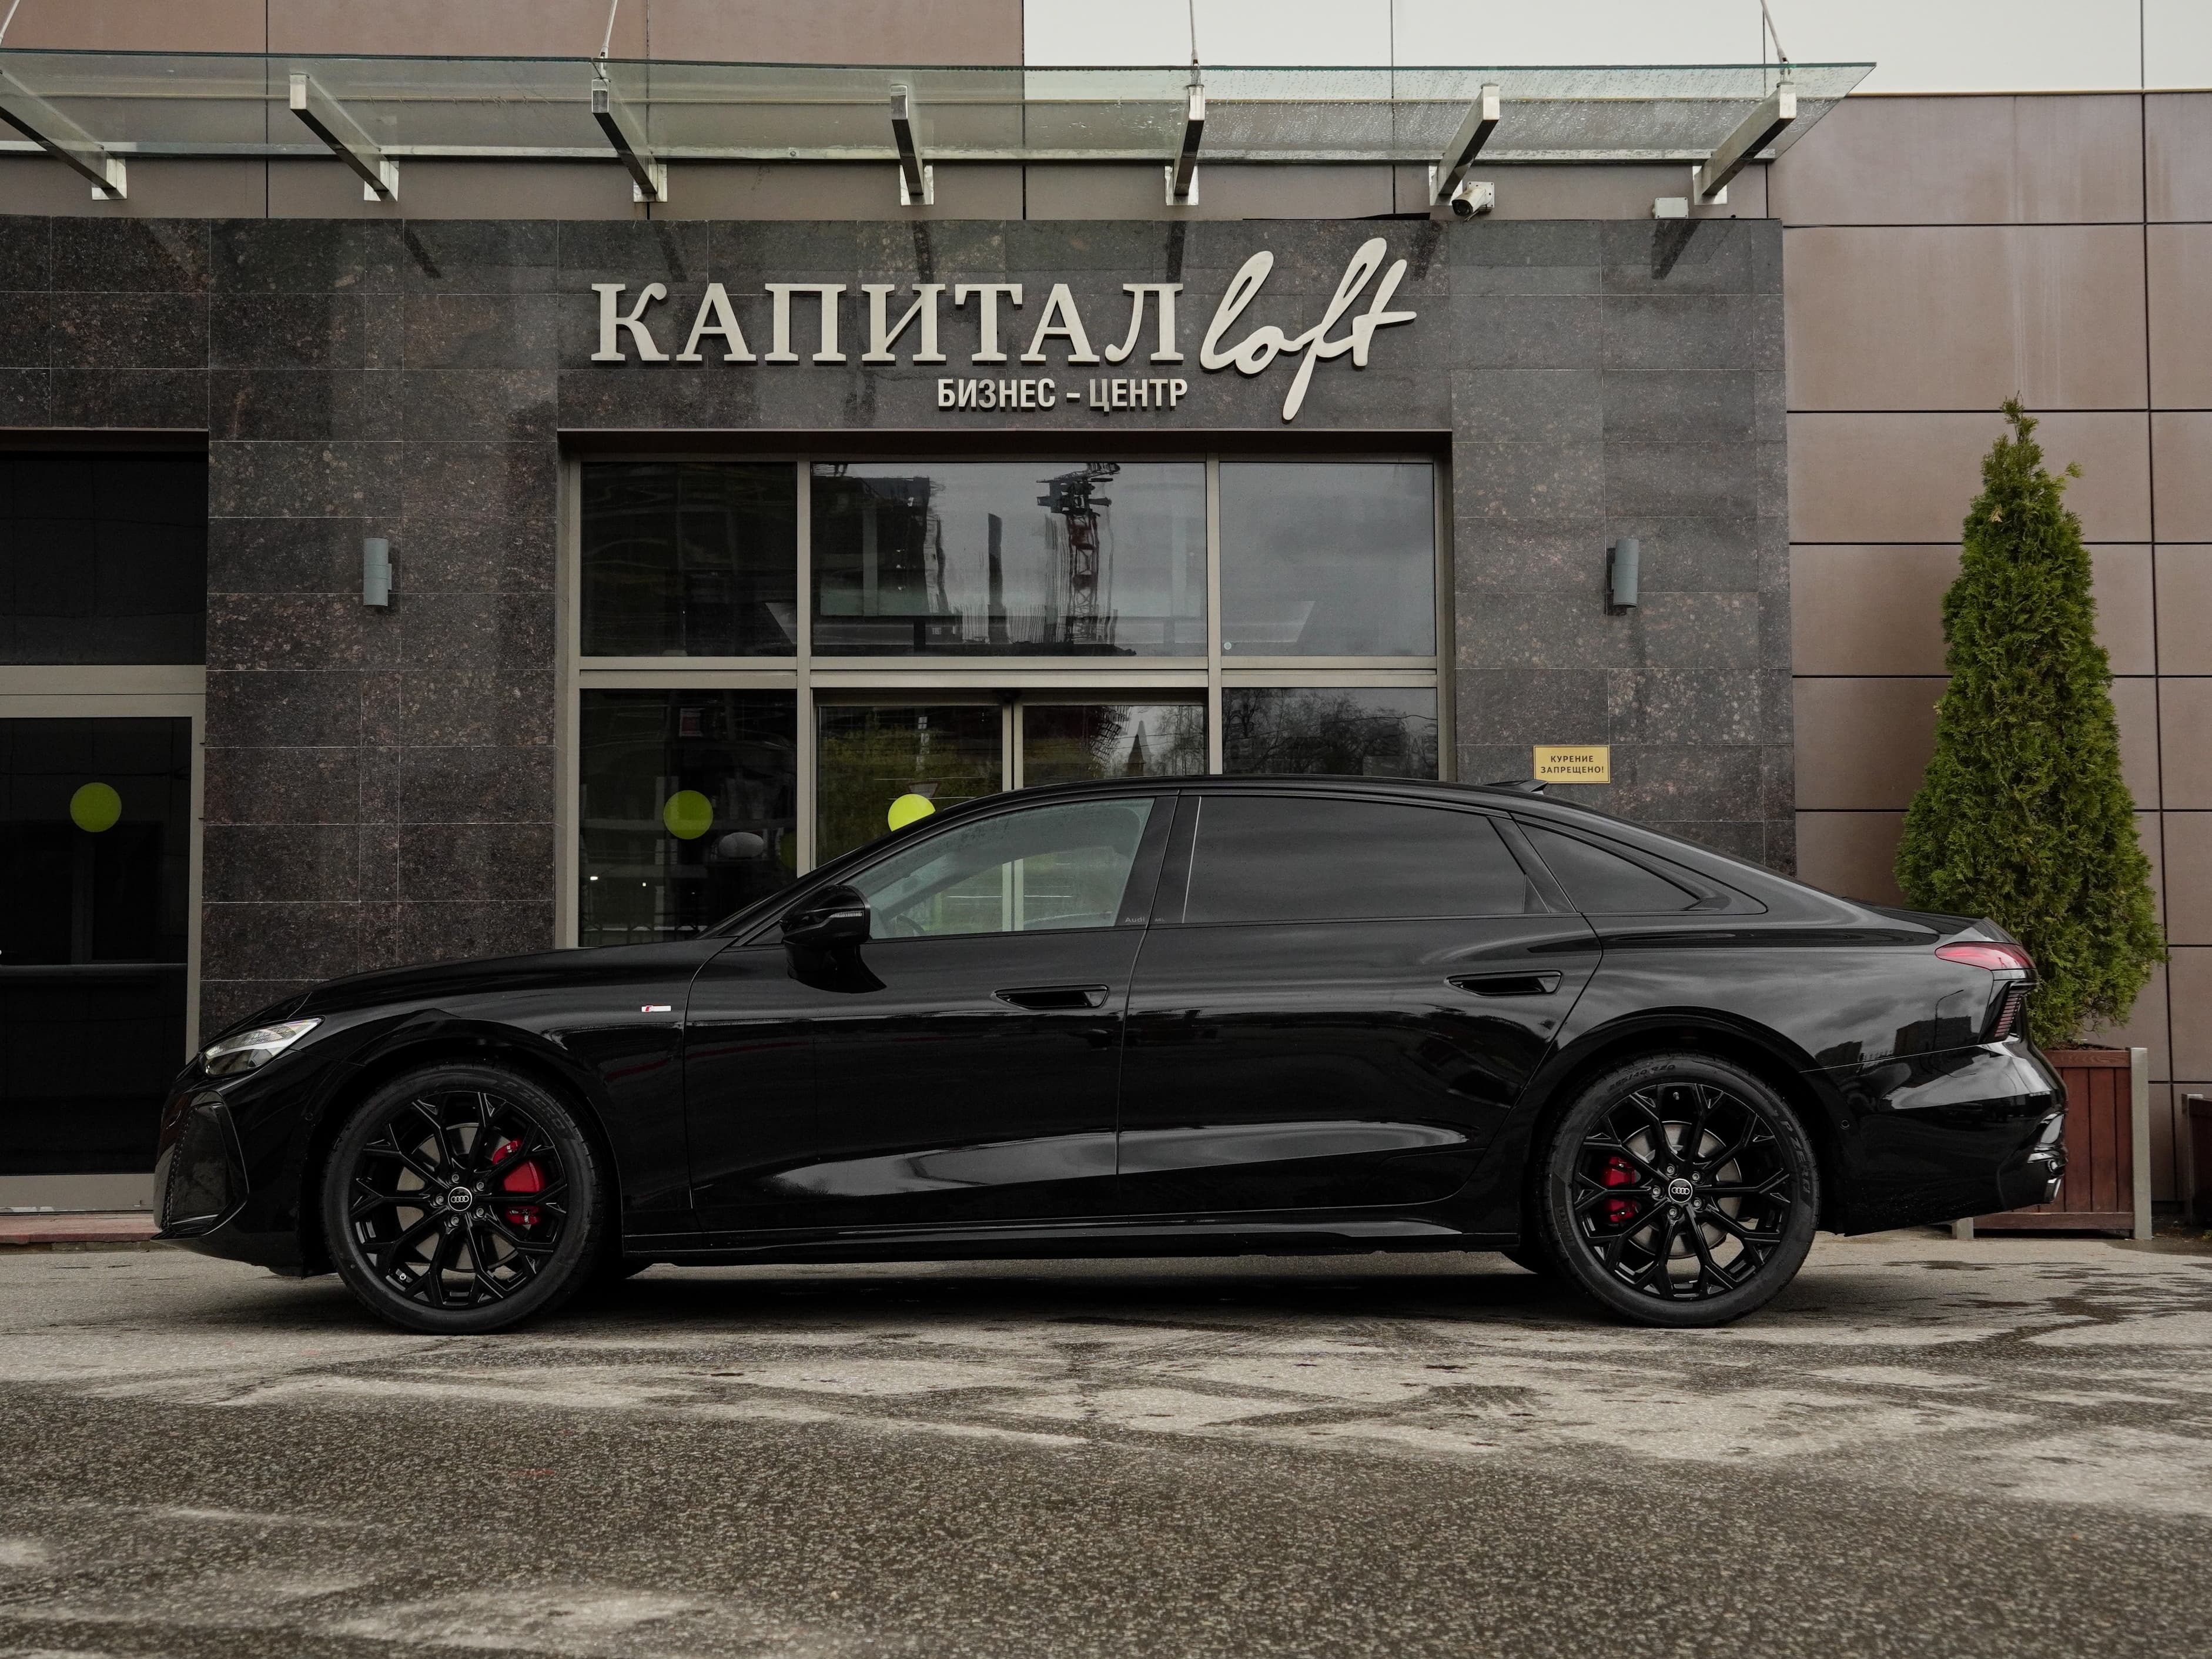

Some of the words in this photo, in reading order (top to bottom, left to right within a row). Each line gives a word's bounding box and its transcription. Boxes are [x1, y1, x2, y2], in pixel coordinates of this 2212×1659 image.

[590, 283, 1184, 362] КАПИТАЛ
[1199, 237, 1418, 421] loft
[938, 377, 1056, 409] БИЗНЕС
[1089, 378, 1189, 413] ЦЕНТР
[1540, 766, 1604, 774] ЗАПРЕЩЕНО!
[1780, 1121, 1793, 1132] P
[1790, 1136, 1811, 1195] ZERO
